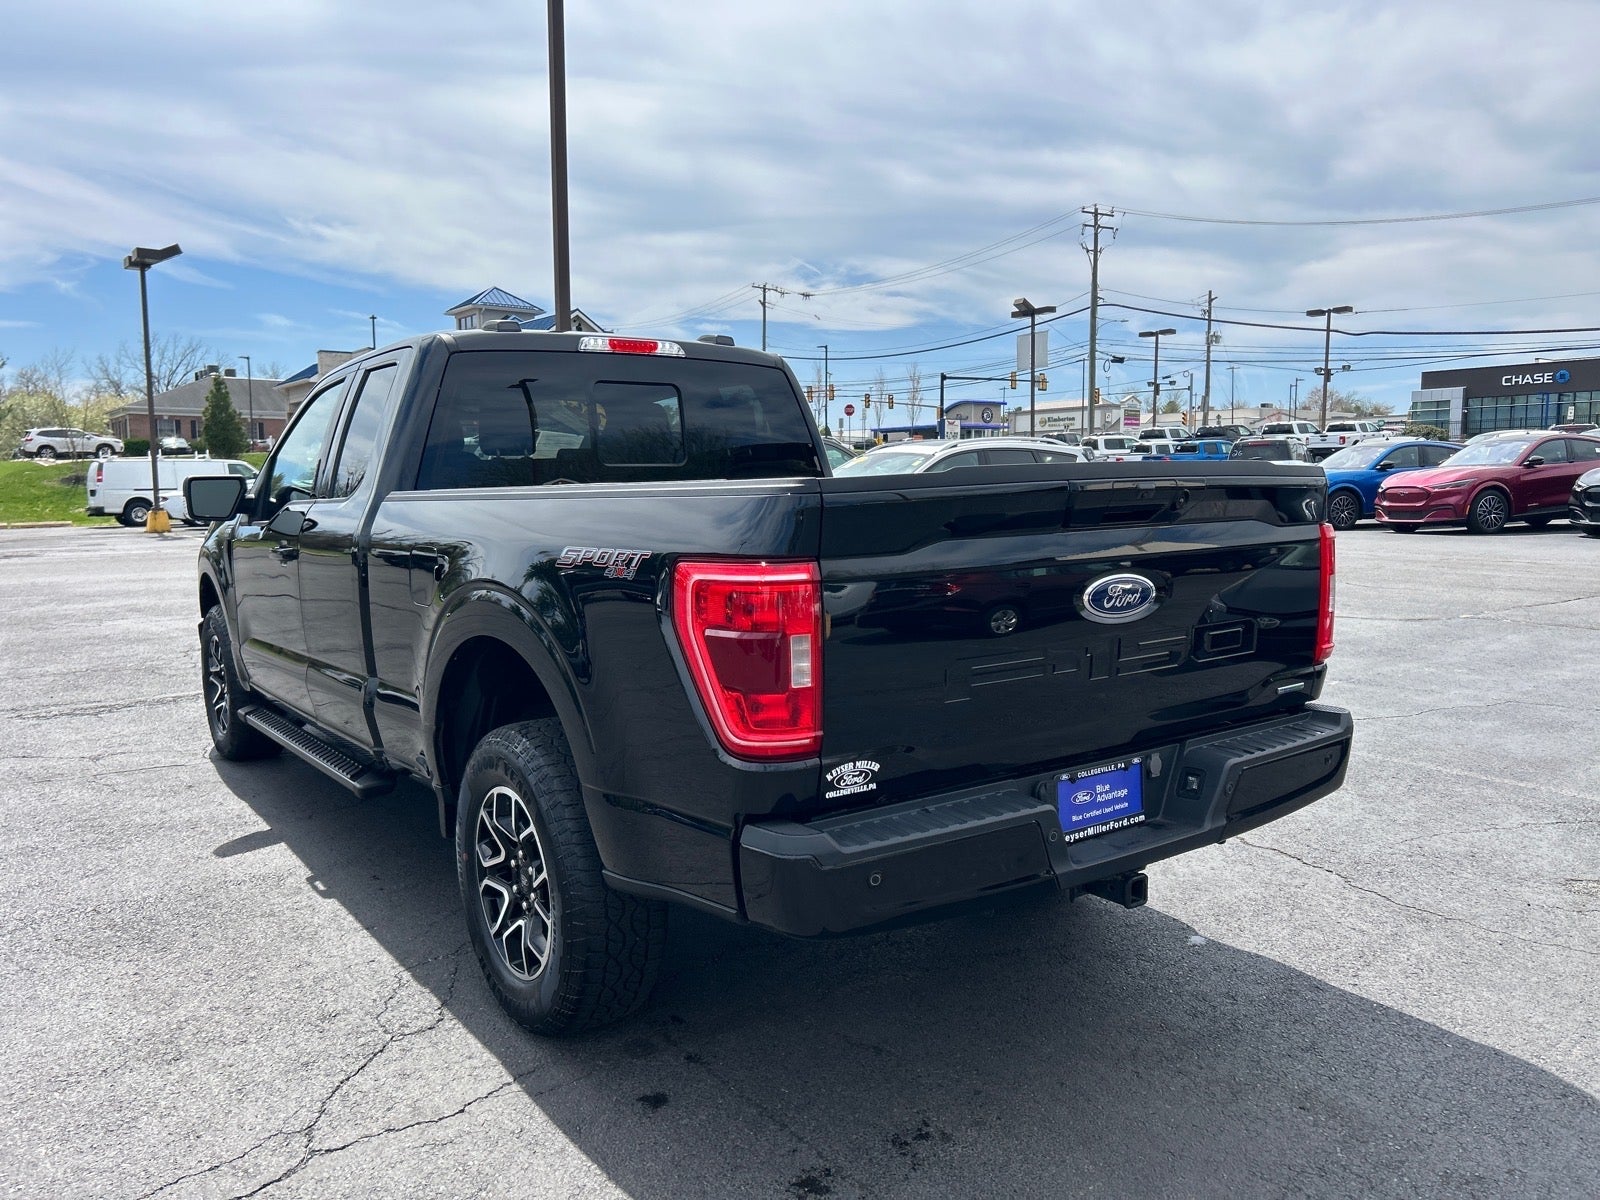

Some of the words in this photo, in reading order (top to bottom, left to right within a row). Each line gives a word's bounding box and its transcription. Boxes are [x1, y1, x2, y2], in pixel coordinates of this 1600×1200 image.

[1501, 372, 1554, 386] CHASE
[1047, 415, 1076, 423] Kimberton
[555, 546, 652, 569] SPORT
[1104, 583, 1142, 608] Ford
[825, 762, 854, 782] KEYSER
[855, 760, 881, 772] MILLER
[840, 771, 865, 786] Ford
[1077, 765, 1117, 778] COLLEGEVILLE,
[1096, 783, 1110, 793] Blue
[1096, 788, 1128, 803] Advantage
[1075, 792, 1091, 803] Ford
[1083, 808, 1102, 819] Certified
[1102, 805, 1114, 814] Used
[1114, 802, 1129, 810] Vehicle
[1064, 815, 1145, 842] eyserMillerFord.com
